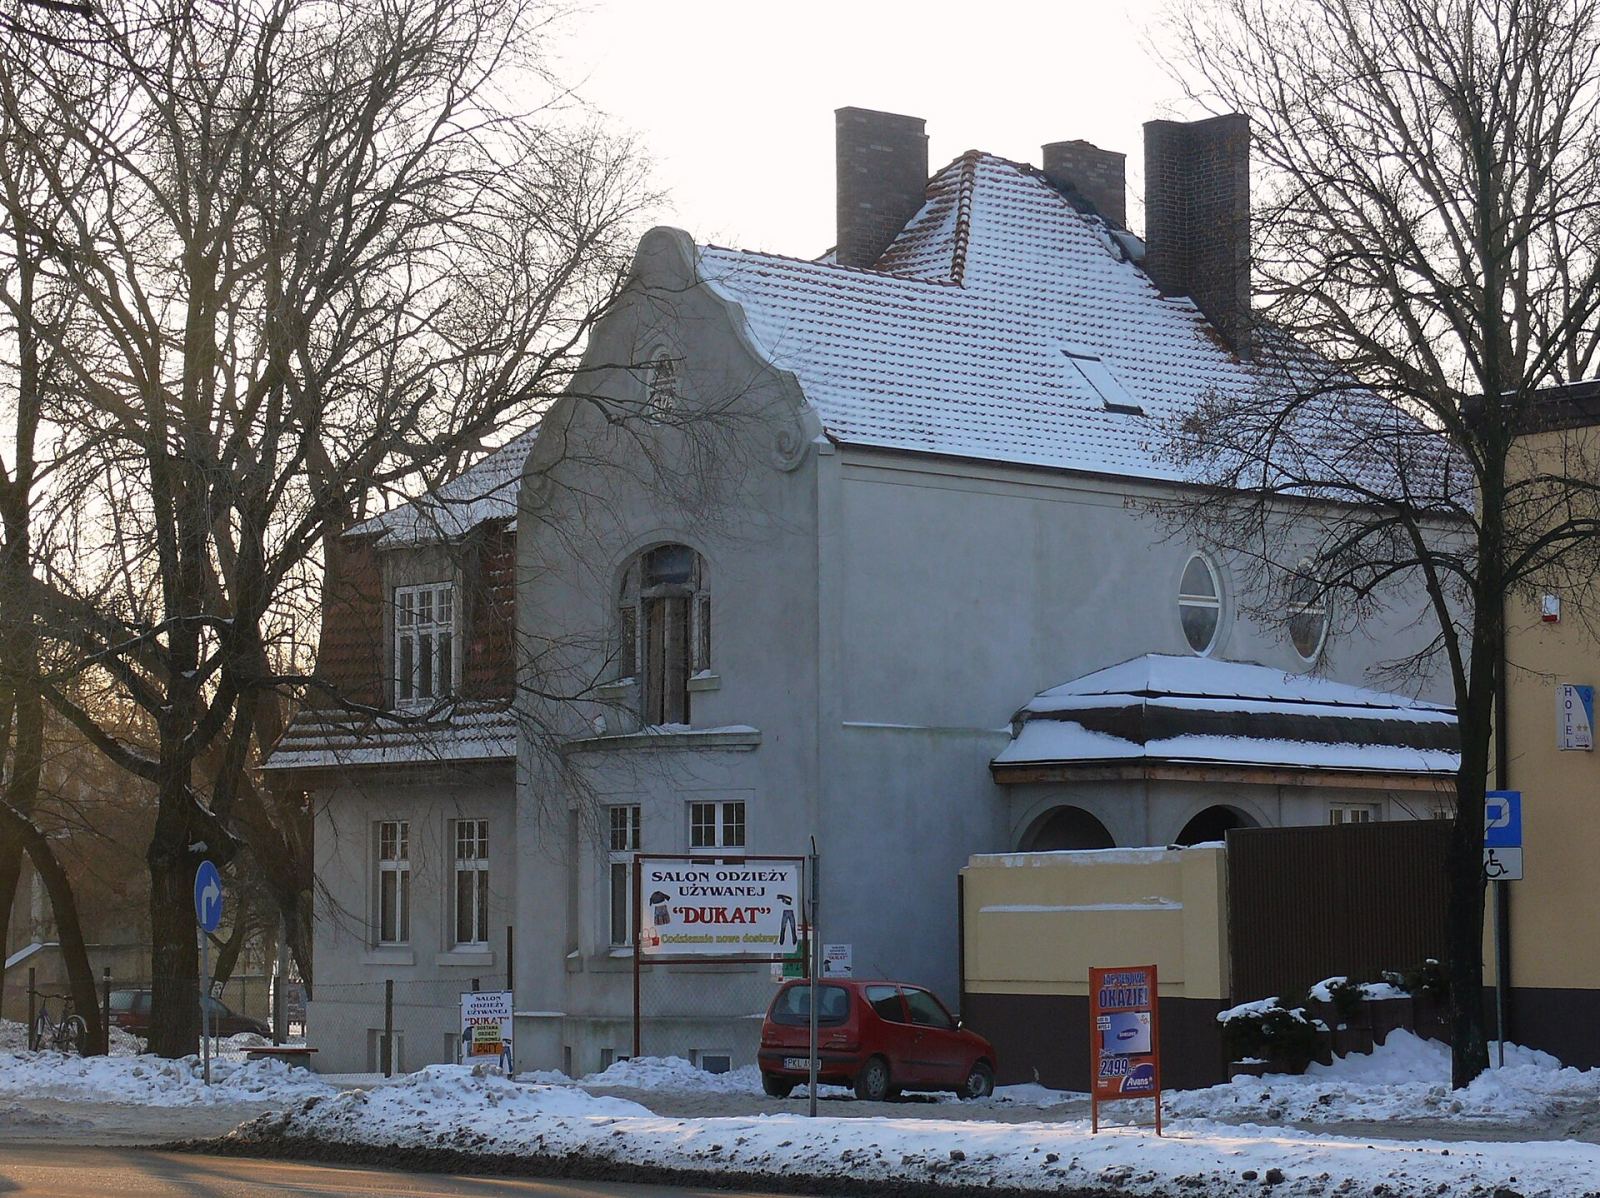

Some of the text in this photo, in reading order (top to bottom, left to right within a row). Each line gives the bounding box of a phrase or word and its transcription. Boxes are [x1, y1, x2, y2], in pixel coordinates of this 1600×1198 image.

[1564, 687, 1573, 748] HOTEL
[1484, 797, 1510, 840] P
[651, 869, 788, 882] SALON ODZIEŻY
[679, 883, 766, 897] UŻYWANEJ
[660, 933, 779, 945] Codziennie nowe dostawy
[1100, 988, 1148, 1007] OKAZJE!
[1101, 1059, 1128, 1076] 2499
[1127, 1077, 1149, 1086] Avans
